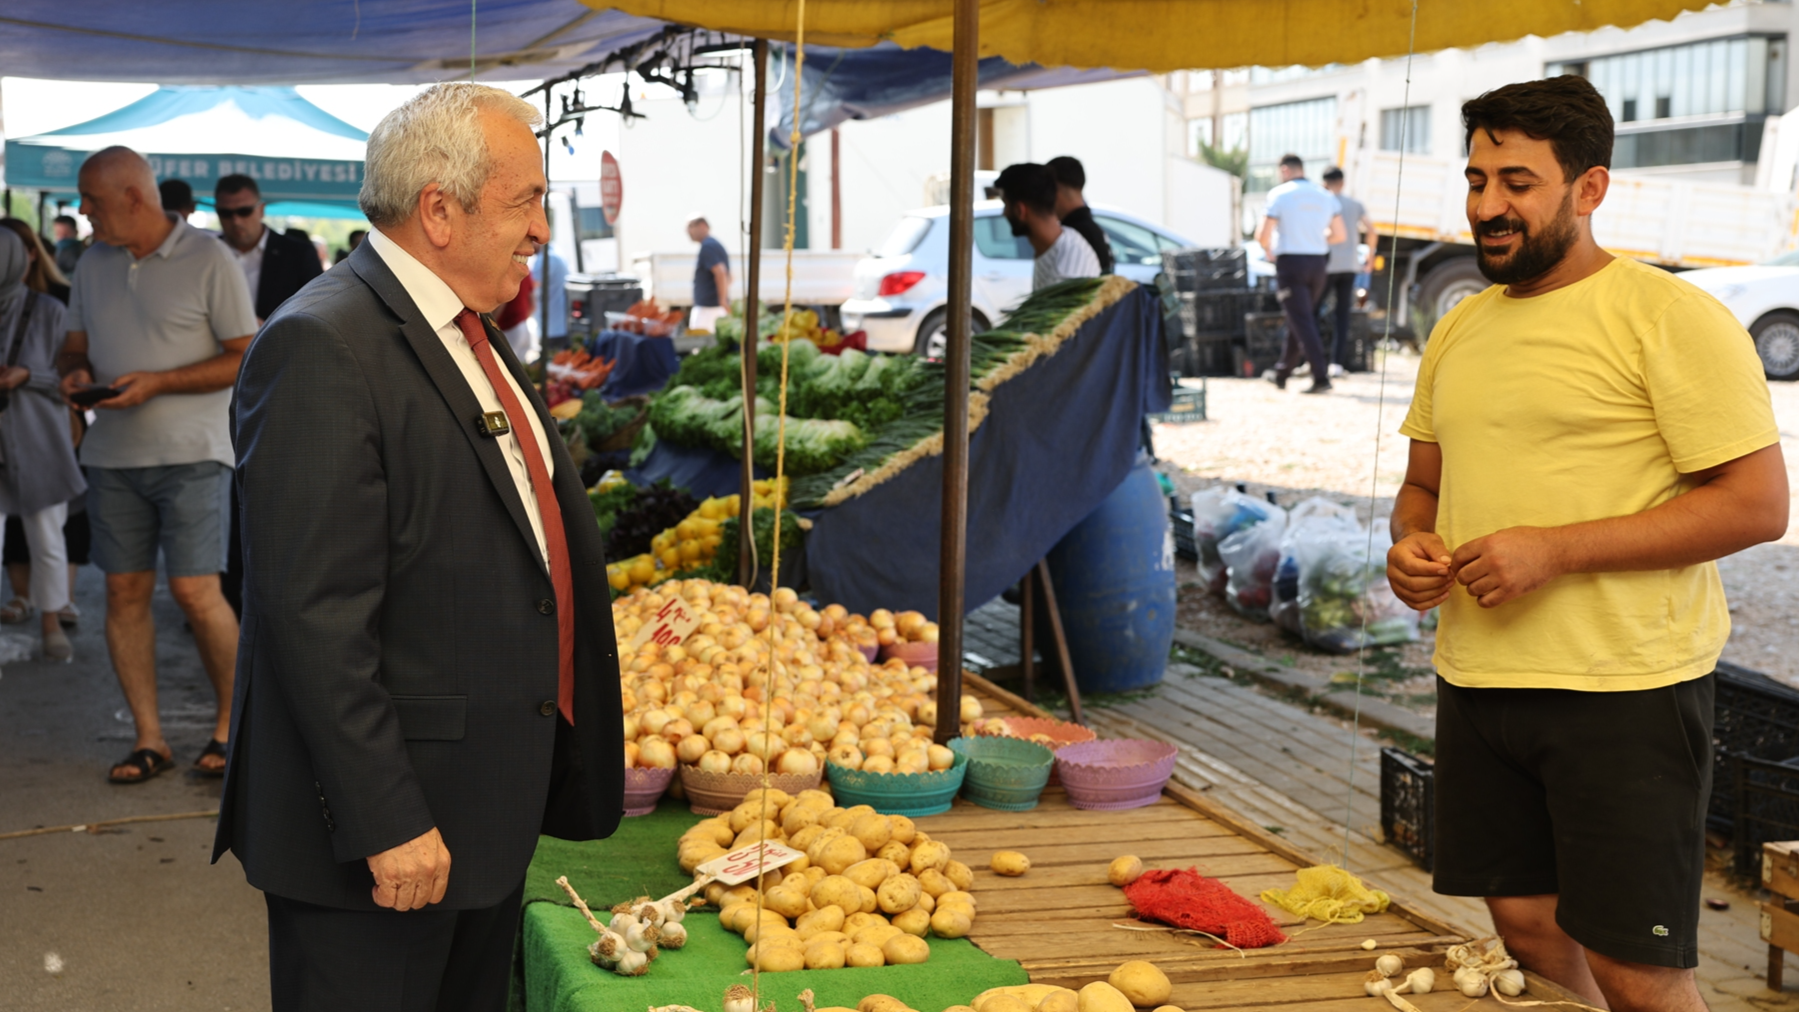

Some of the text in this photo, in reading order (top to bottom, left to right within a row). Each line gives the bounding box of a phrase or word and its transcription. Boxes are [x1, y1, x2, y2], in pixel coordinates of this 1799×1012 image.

[149, 157, 356, 183] ÜFER BELEDİYESİ
[656, 598, 677, 623] 4
